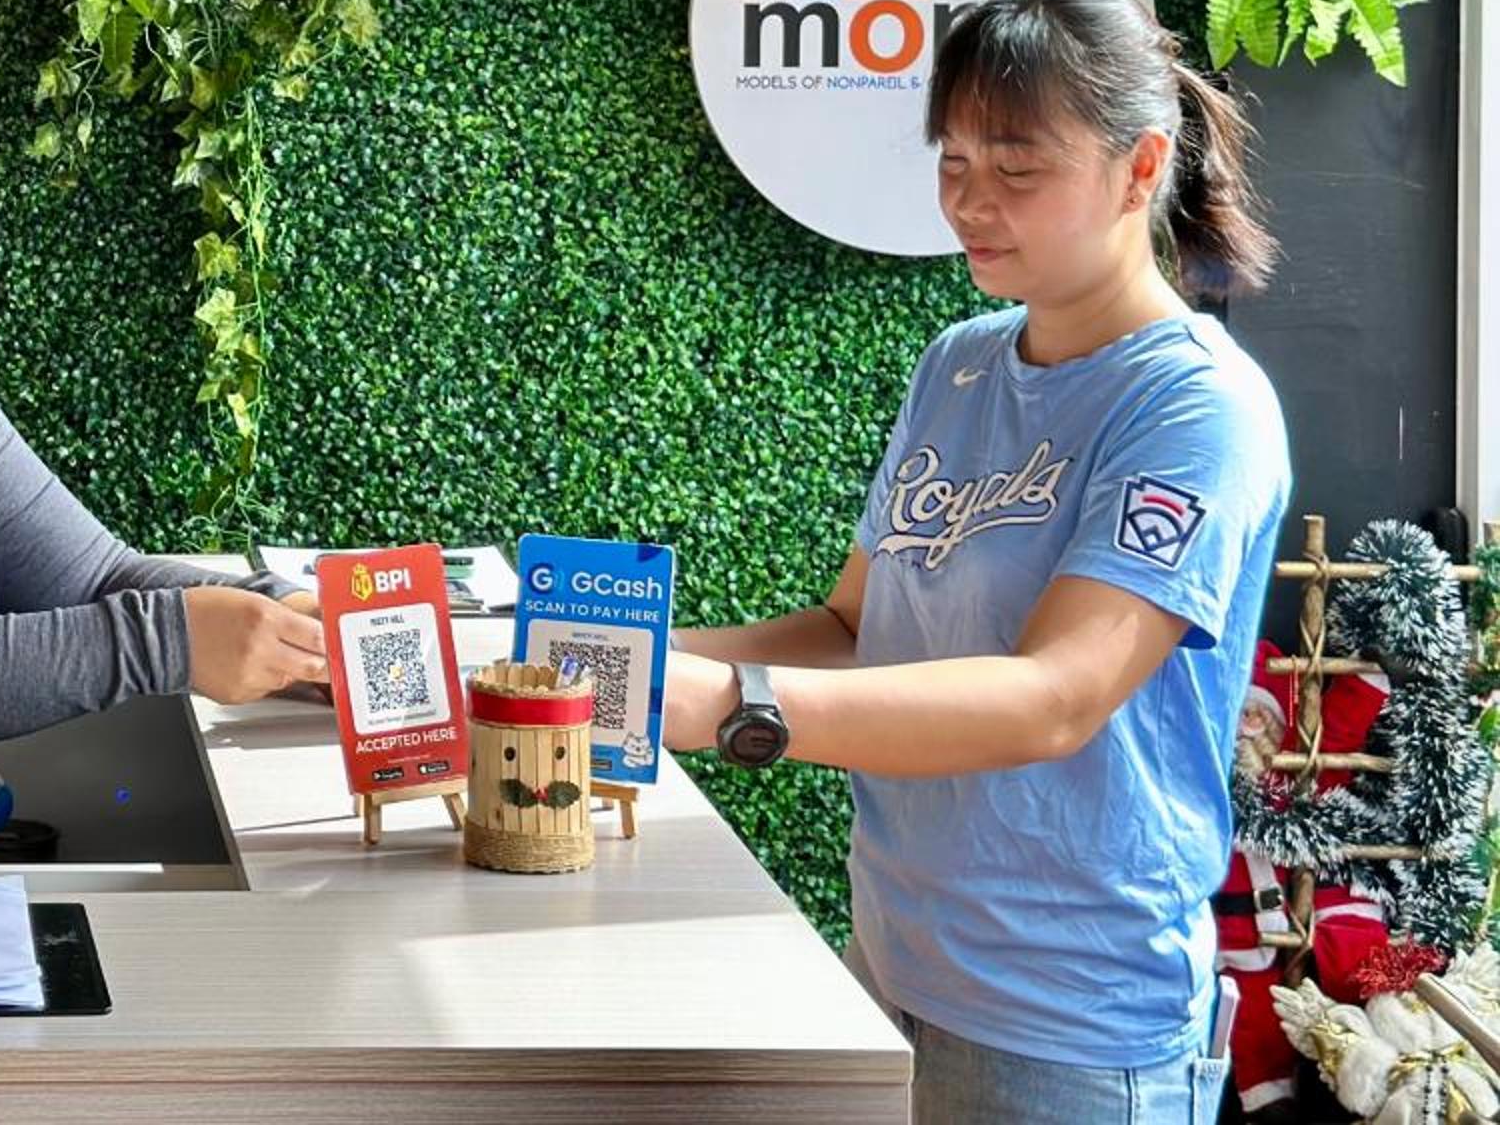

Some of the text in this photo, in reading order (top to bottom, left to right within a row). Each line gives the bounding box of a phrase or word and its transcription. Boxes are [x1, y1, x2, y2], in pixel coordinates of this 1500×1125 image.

[735, 75, 797, 90] MODELS
[801, 75, 824, 90] OF
[826, 75, 903, 90] NONPAREIL
[874, 438, 1073, 571] Royals
[374, 567, 412, 594] BPI
[570, 571, 663, 601] GCash
[524, 599, 661, 624] SCAN TO PAY HERE
[355, 726, 458, 755] ACCEPTED HERE
